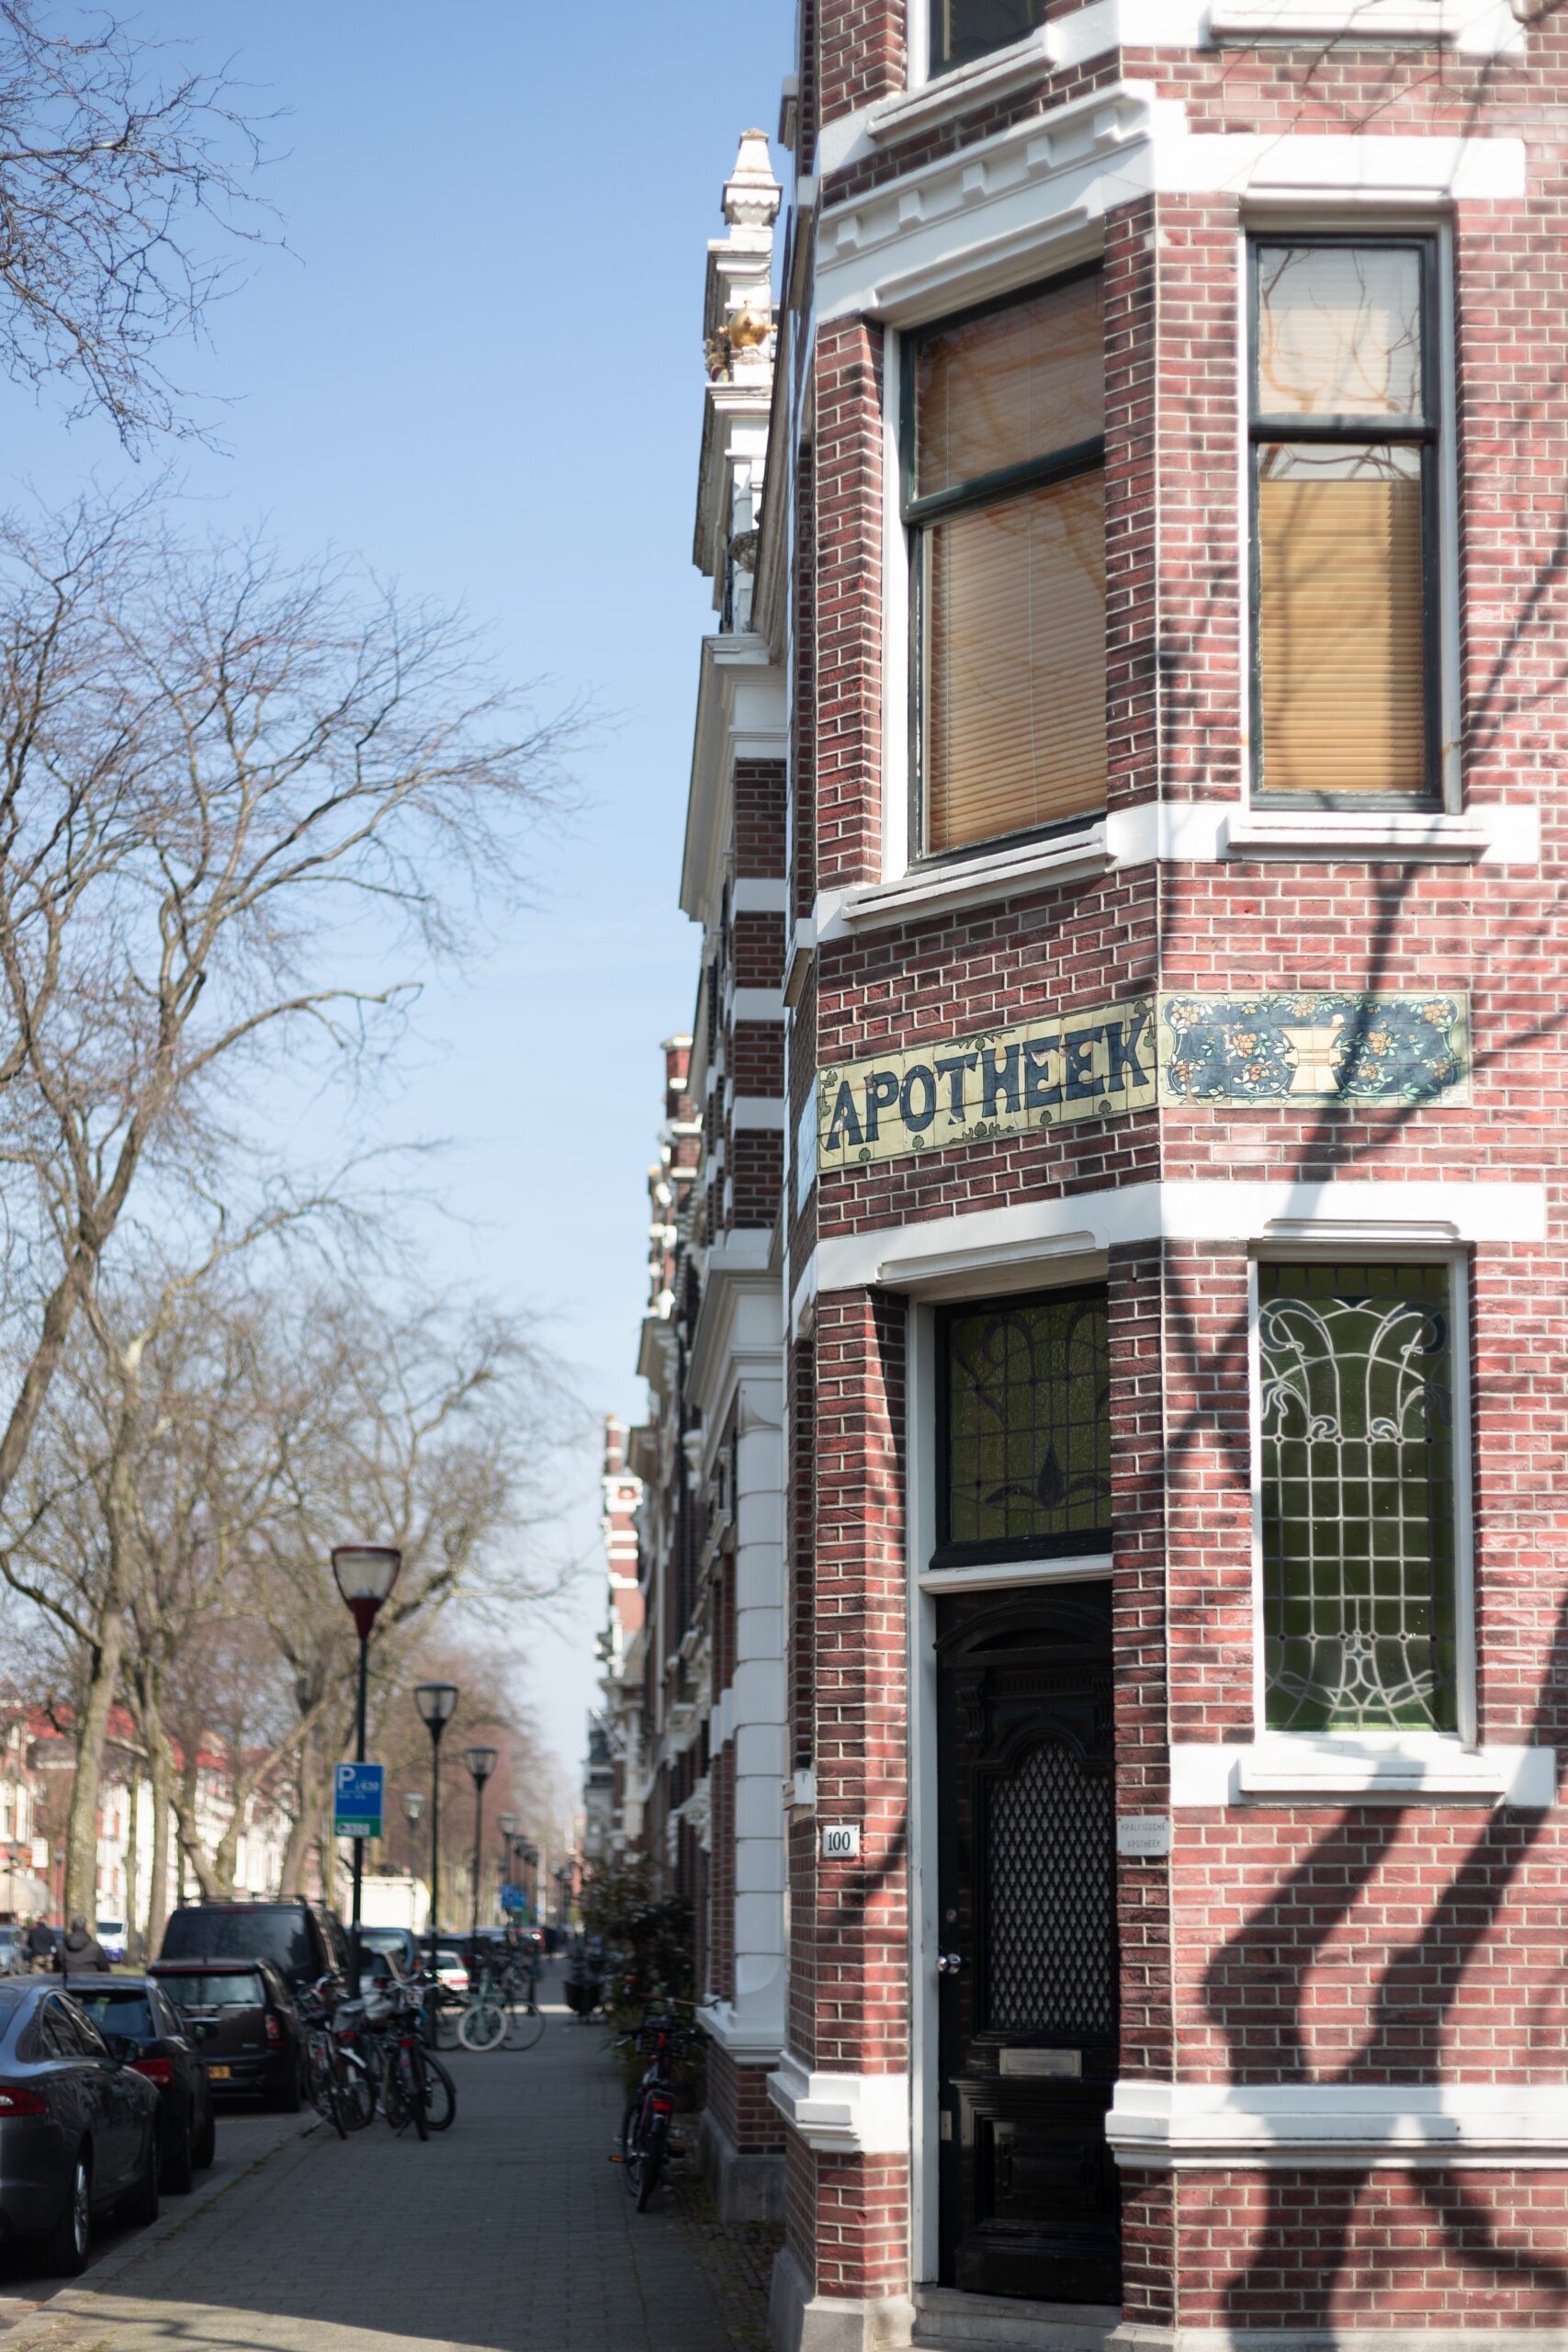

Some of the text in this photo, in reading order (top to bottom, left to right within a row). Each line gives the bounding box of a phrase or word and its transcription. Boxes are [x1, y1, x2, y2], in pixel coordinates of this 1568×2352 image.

[825, 1015, 1150, 1151] APOTHEEK
[338, 1766, 356, 1791] P
[828, 1831, 851, 1851] 100
[1127, 1839, 1162, 1849] APOTHEEK
